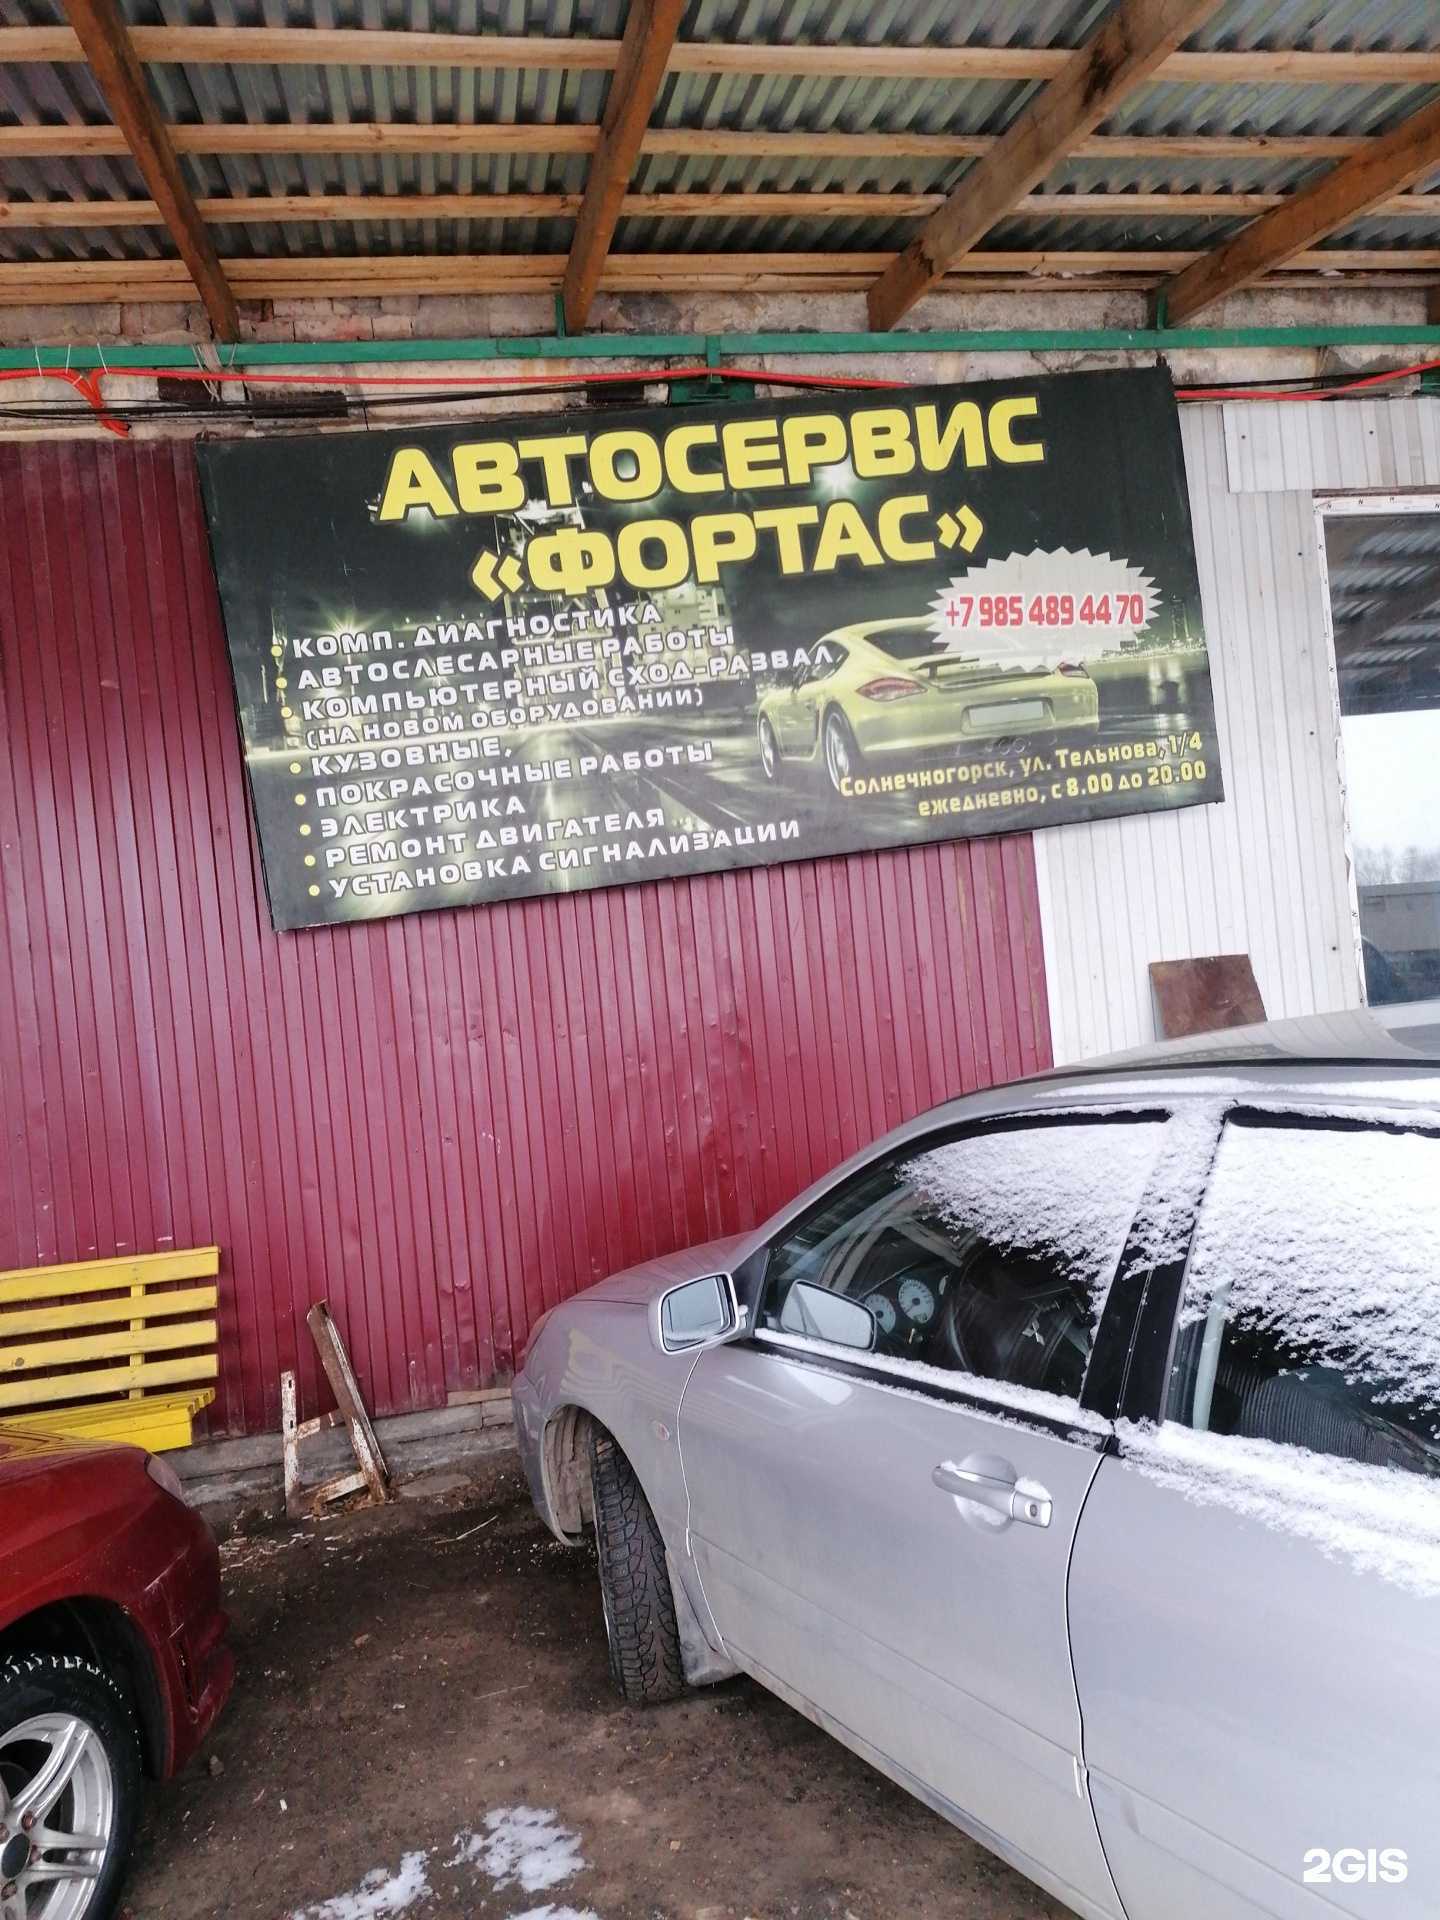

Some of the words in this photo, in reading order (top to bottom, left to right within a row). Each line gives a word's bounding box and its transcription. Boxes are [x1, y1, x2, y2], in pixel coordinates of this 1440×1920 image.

[378, 396, 1045, 521] АВТОСЕРВИС
[471, 494, 985, 602] «ФОРТАС»
[293, 630, 406, 658] КОМП.
[414, 603, 663, 648] ДИАГНОСТИКА
[946, 597, 974, 628] +7
[979, 596, 1024, 627] 985
[1028, 595, 1074, 626] 489
[1079, 595, 1112, 625] 44
[1116, 594, 1144, 625] 70
[298, 640, 594, 690] АВТОСЛЕСАРНЫЕ
[603, 626, 734, 658] РАБОТЫ
[303, 669, 599, 721] КОМПЬЮТЕРНЫЙ
[608, 645, 834, 688] СХОД-РАЗВАЛ
[306, 726, 357, 750] (НА
[363, 714, 465, 743] НОВОМ
[472, 688, 704, 728] ОБОРУДОВАНИИ)
[311, 737, 513, 776] КУЗОВНЫЕ,
[315, 758, 572, 807] ПОКРАСОЧНЫЕ
[579, 742, 714, 776] РАБОТЫ
[839, 759, 1017, 796] Солнечногорск,
[1019, 756, 1051, 777] ул.
[1056, 742, 1166, 770] Тельнова,
[1169, 735, 1202, 756] 1/4
[321, 796, 526, 837] ЭЛЕКТРИКА
[918, 785, 1046, 817] ежедневно,
[1067, 774, 1112, 796] 8.00
[1147, 762, 1206, 786] 20.00
[326, 834, 467, 869] РЕМОНТ
[475, 809, 665, 849] ДВИГАТЕЛЯ
[329, 859, 531, 899] УСТАНОВКА
[539, 820, 800, 871] СИГНАЛИЗАЦИИ
